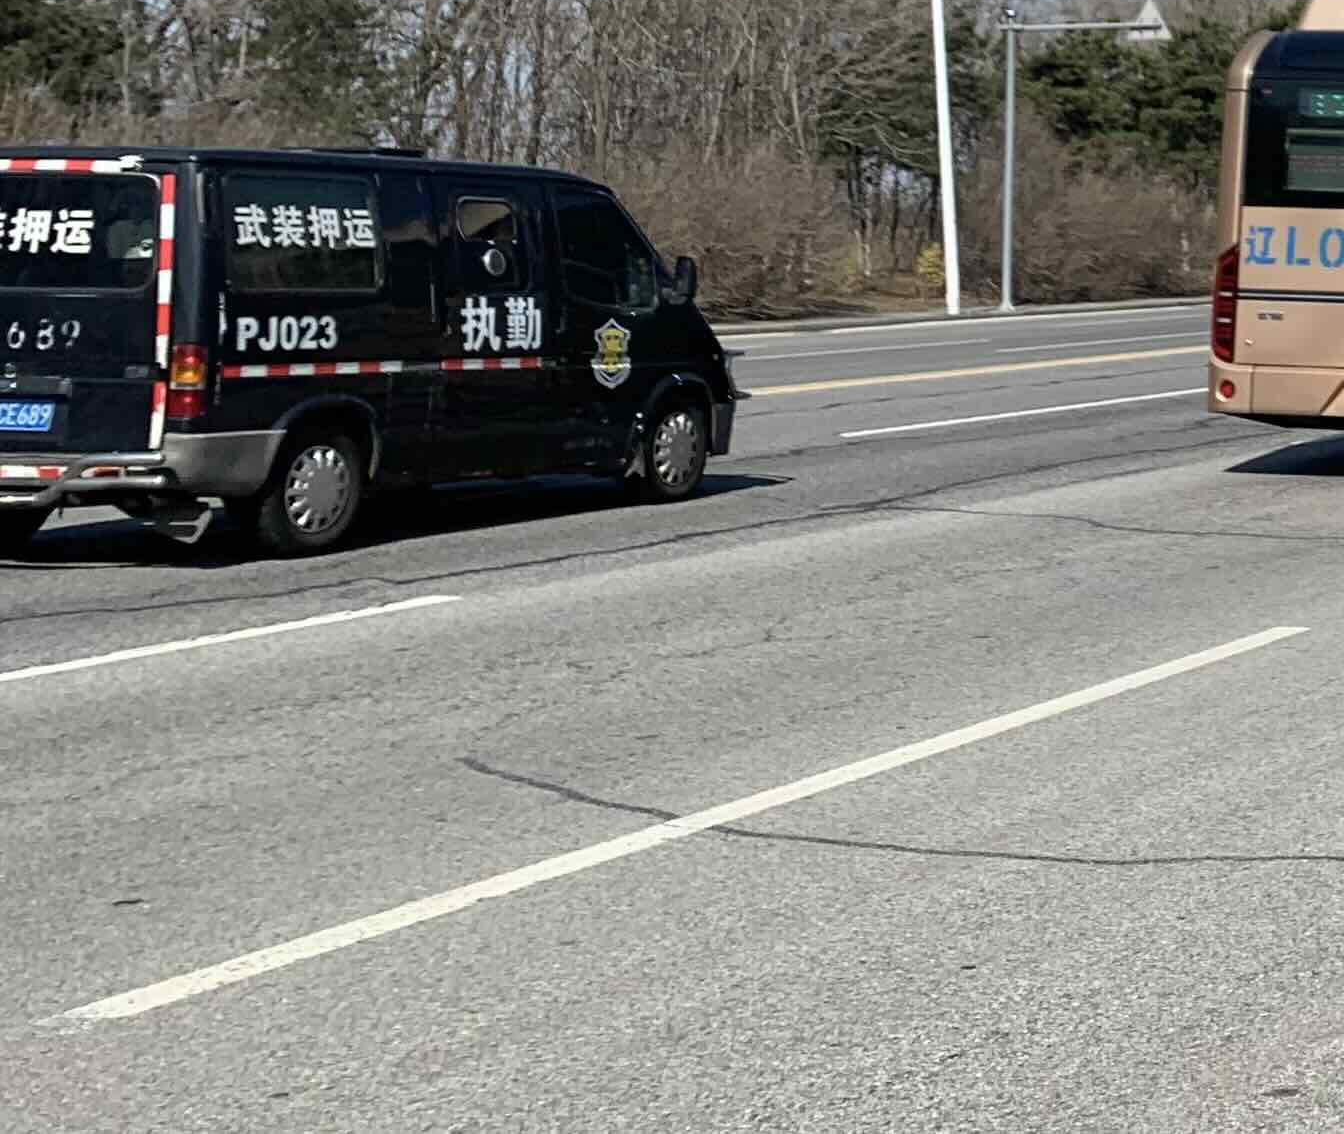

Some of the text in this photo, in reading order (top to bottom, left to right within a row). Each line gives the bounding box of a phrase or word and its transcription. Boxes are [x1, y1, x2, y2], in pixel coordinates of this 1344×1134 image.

[0, 208, 94, 254] 押运
[233, 204, 376, 248] 武装押运
[236, 316, 338, 351] PJ023
[461, 296, 541, 351] 执勤
